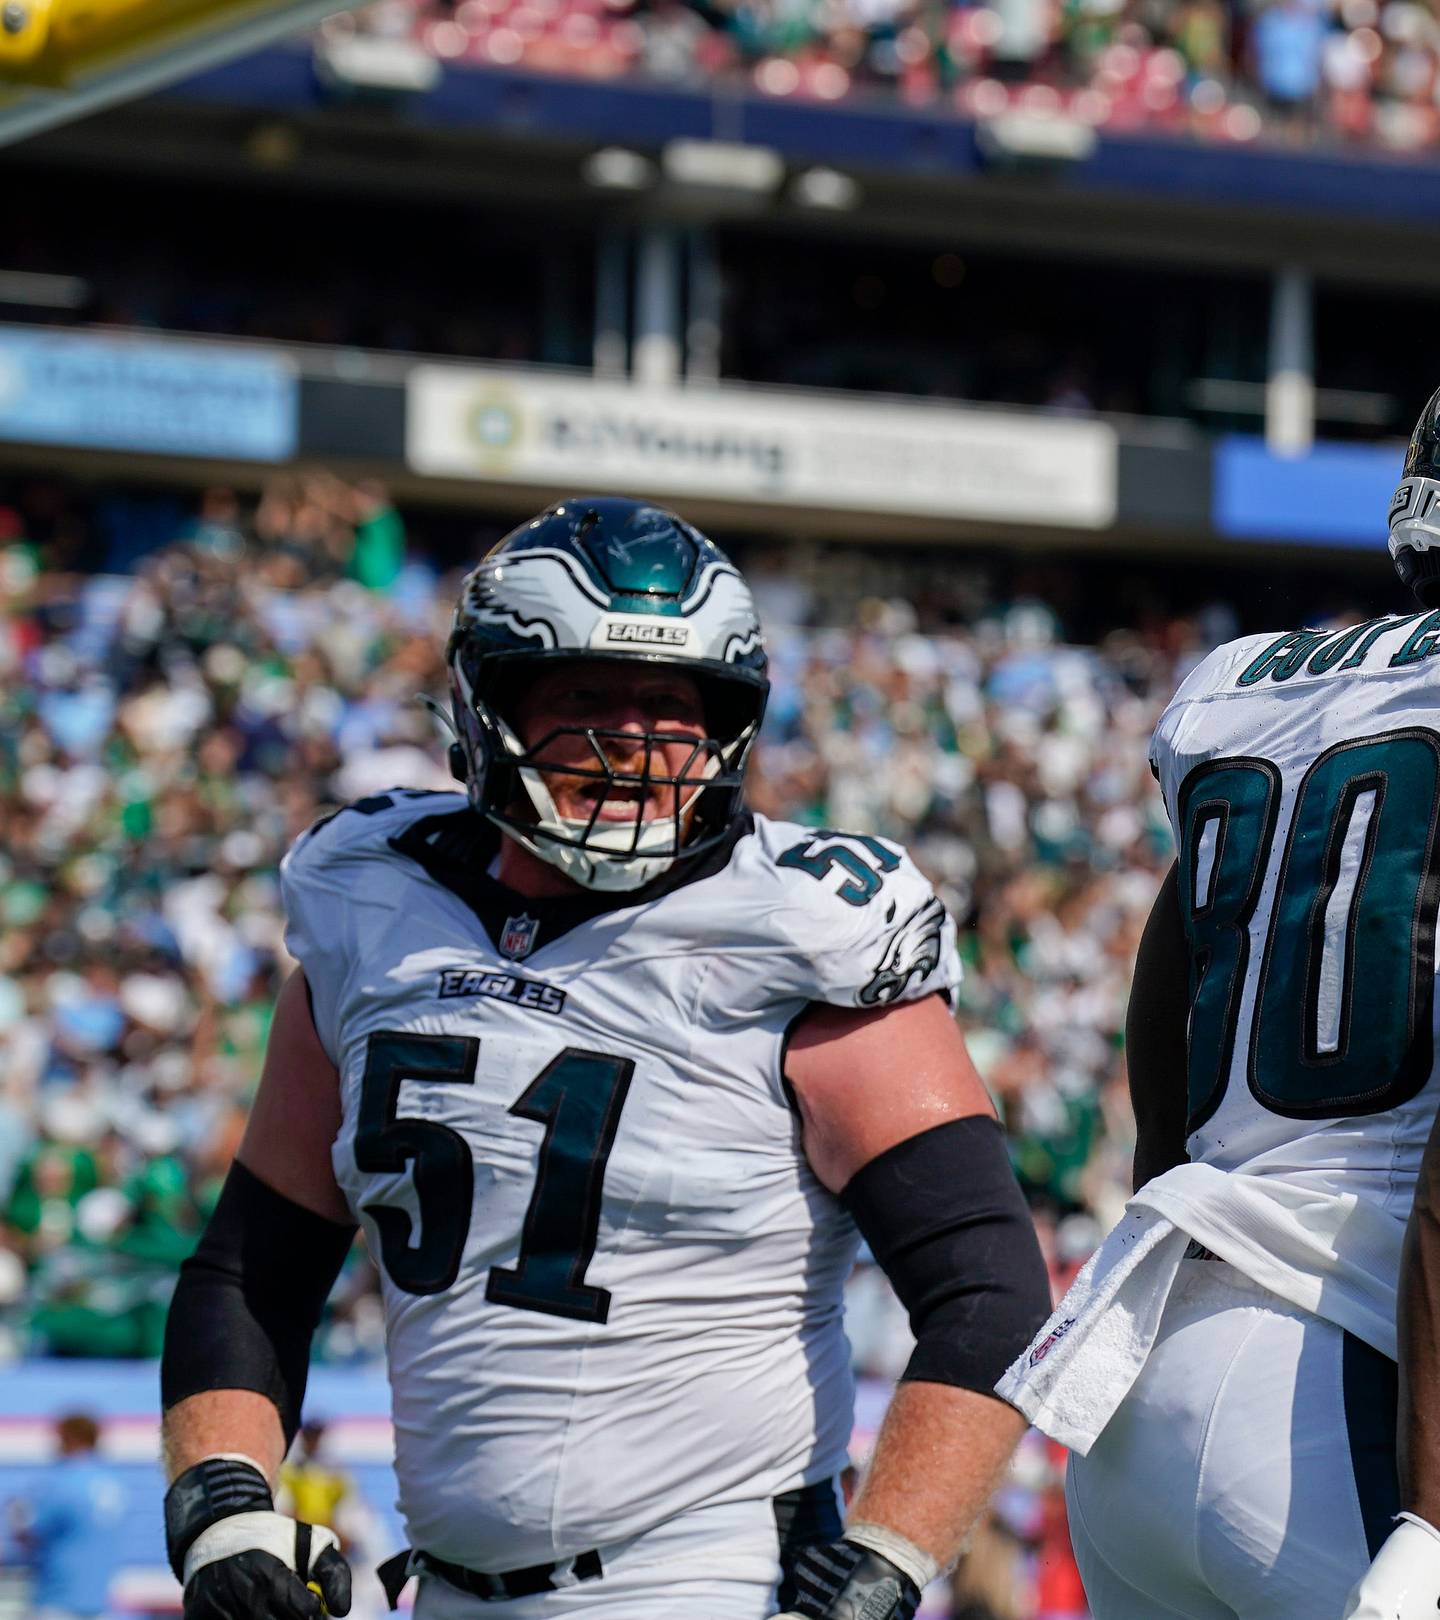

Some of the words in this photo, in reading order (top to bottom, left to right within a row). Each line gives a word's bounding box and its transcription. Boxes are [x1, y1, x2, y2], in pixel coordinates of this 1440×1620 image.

[607, 624, 688, 645] EAGLES
[440, 970, 567, 1014] EAGLES
[353, 1030, 636, 1325] 51
